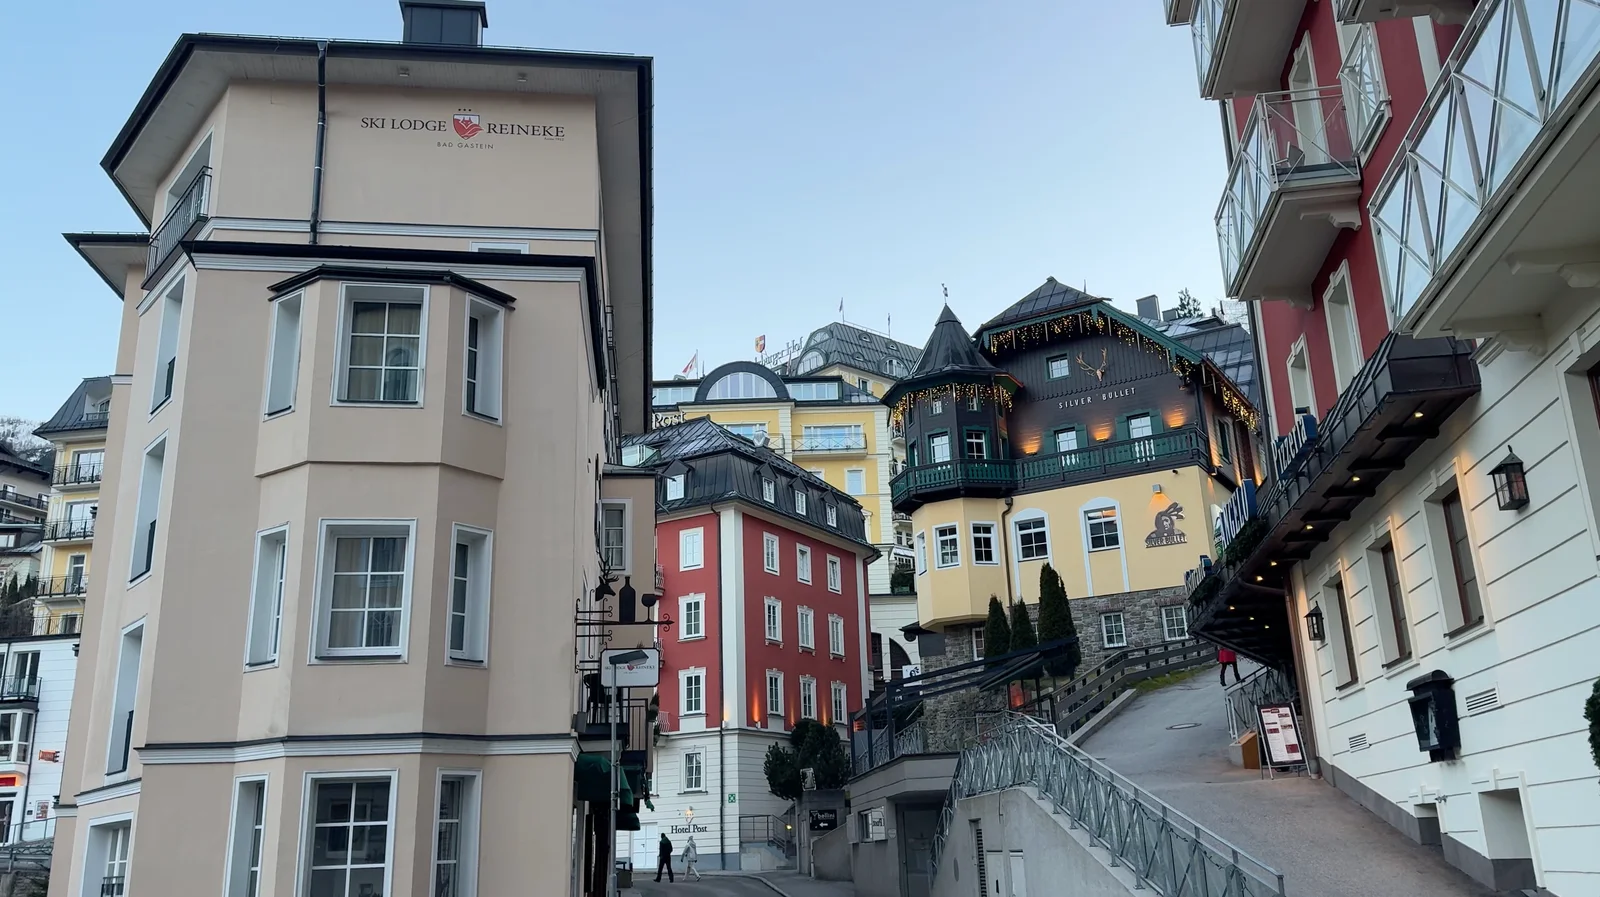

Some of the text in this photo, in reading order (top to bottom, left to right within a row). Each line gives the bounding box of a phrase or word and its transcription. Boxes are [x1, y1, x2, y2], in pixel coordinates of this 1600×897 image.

[360, 116, 565, 138] SKI LODGE REINEKE
[457, 142, 494, 150] GASTEIN
[1058, 387, 1136, 409] SILVER BULLET
[1271, 415, 1308, 480] Pizzeria
[1220, 480, 1250, 551] ANGELO
[671, 824, 708, 834] Hotel Post
